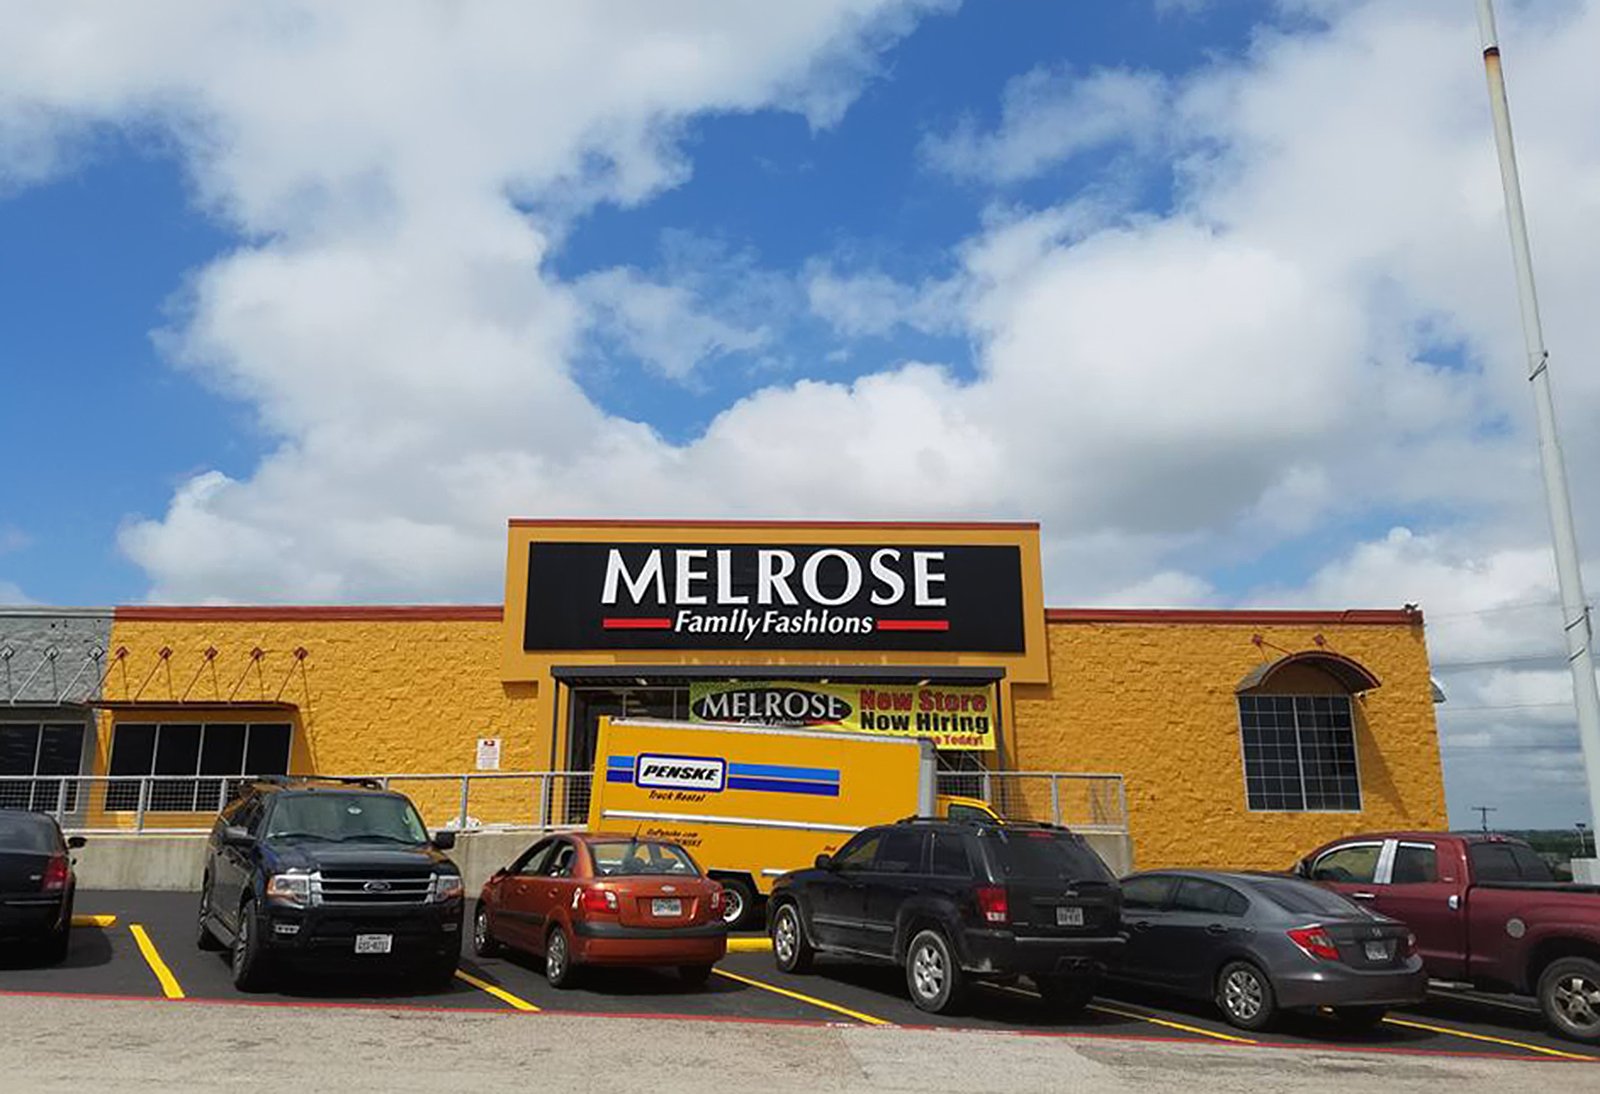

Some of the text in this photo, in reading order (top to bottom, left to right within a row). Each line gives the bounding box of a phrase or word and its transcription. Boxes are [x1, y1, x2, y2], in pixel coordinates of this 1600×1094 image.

[601, 549, 947, 607] MELROSE
[674, 610, 873, 640] Family Fashions
[702, 690, 842, 720] MELROSE
[860, 688, 987, 712] New Store
[860, 712, 989, 734] Now Hiring
[643, 765, 719, 781] PENSKE
[648, 790, 706, 802] Truck Rental
